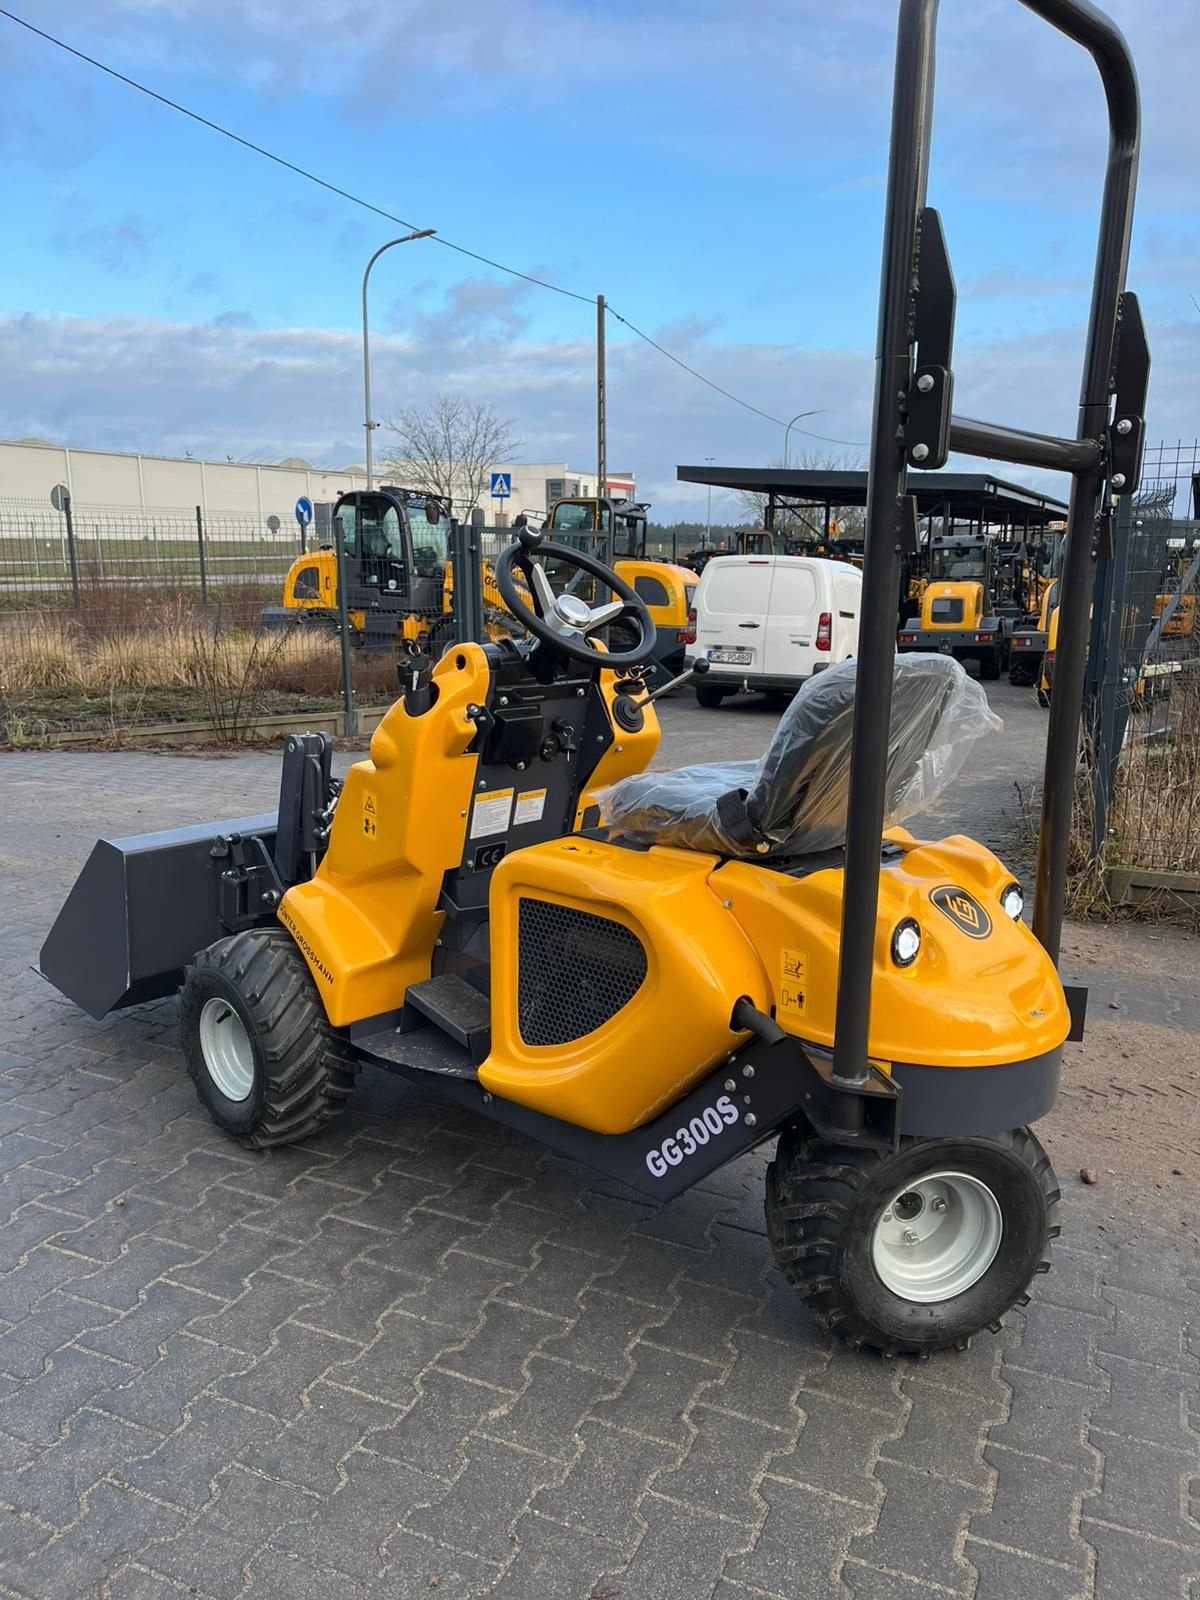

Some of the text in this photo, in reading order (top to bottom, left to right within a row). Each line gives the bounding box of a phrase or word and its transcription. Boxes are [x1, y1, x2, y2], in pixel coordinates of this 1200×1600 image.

[482, 849, 500, 865] CE
[296, 931, 334, 984] GROSSMANN
[646, 1096, 740, 1178] GG300S
